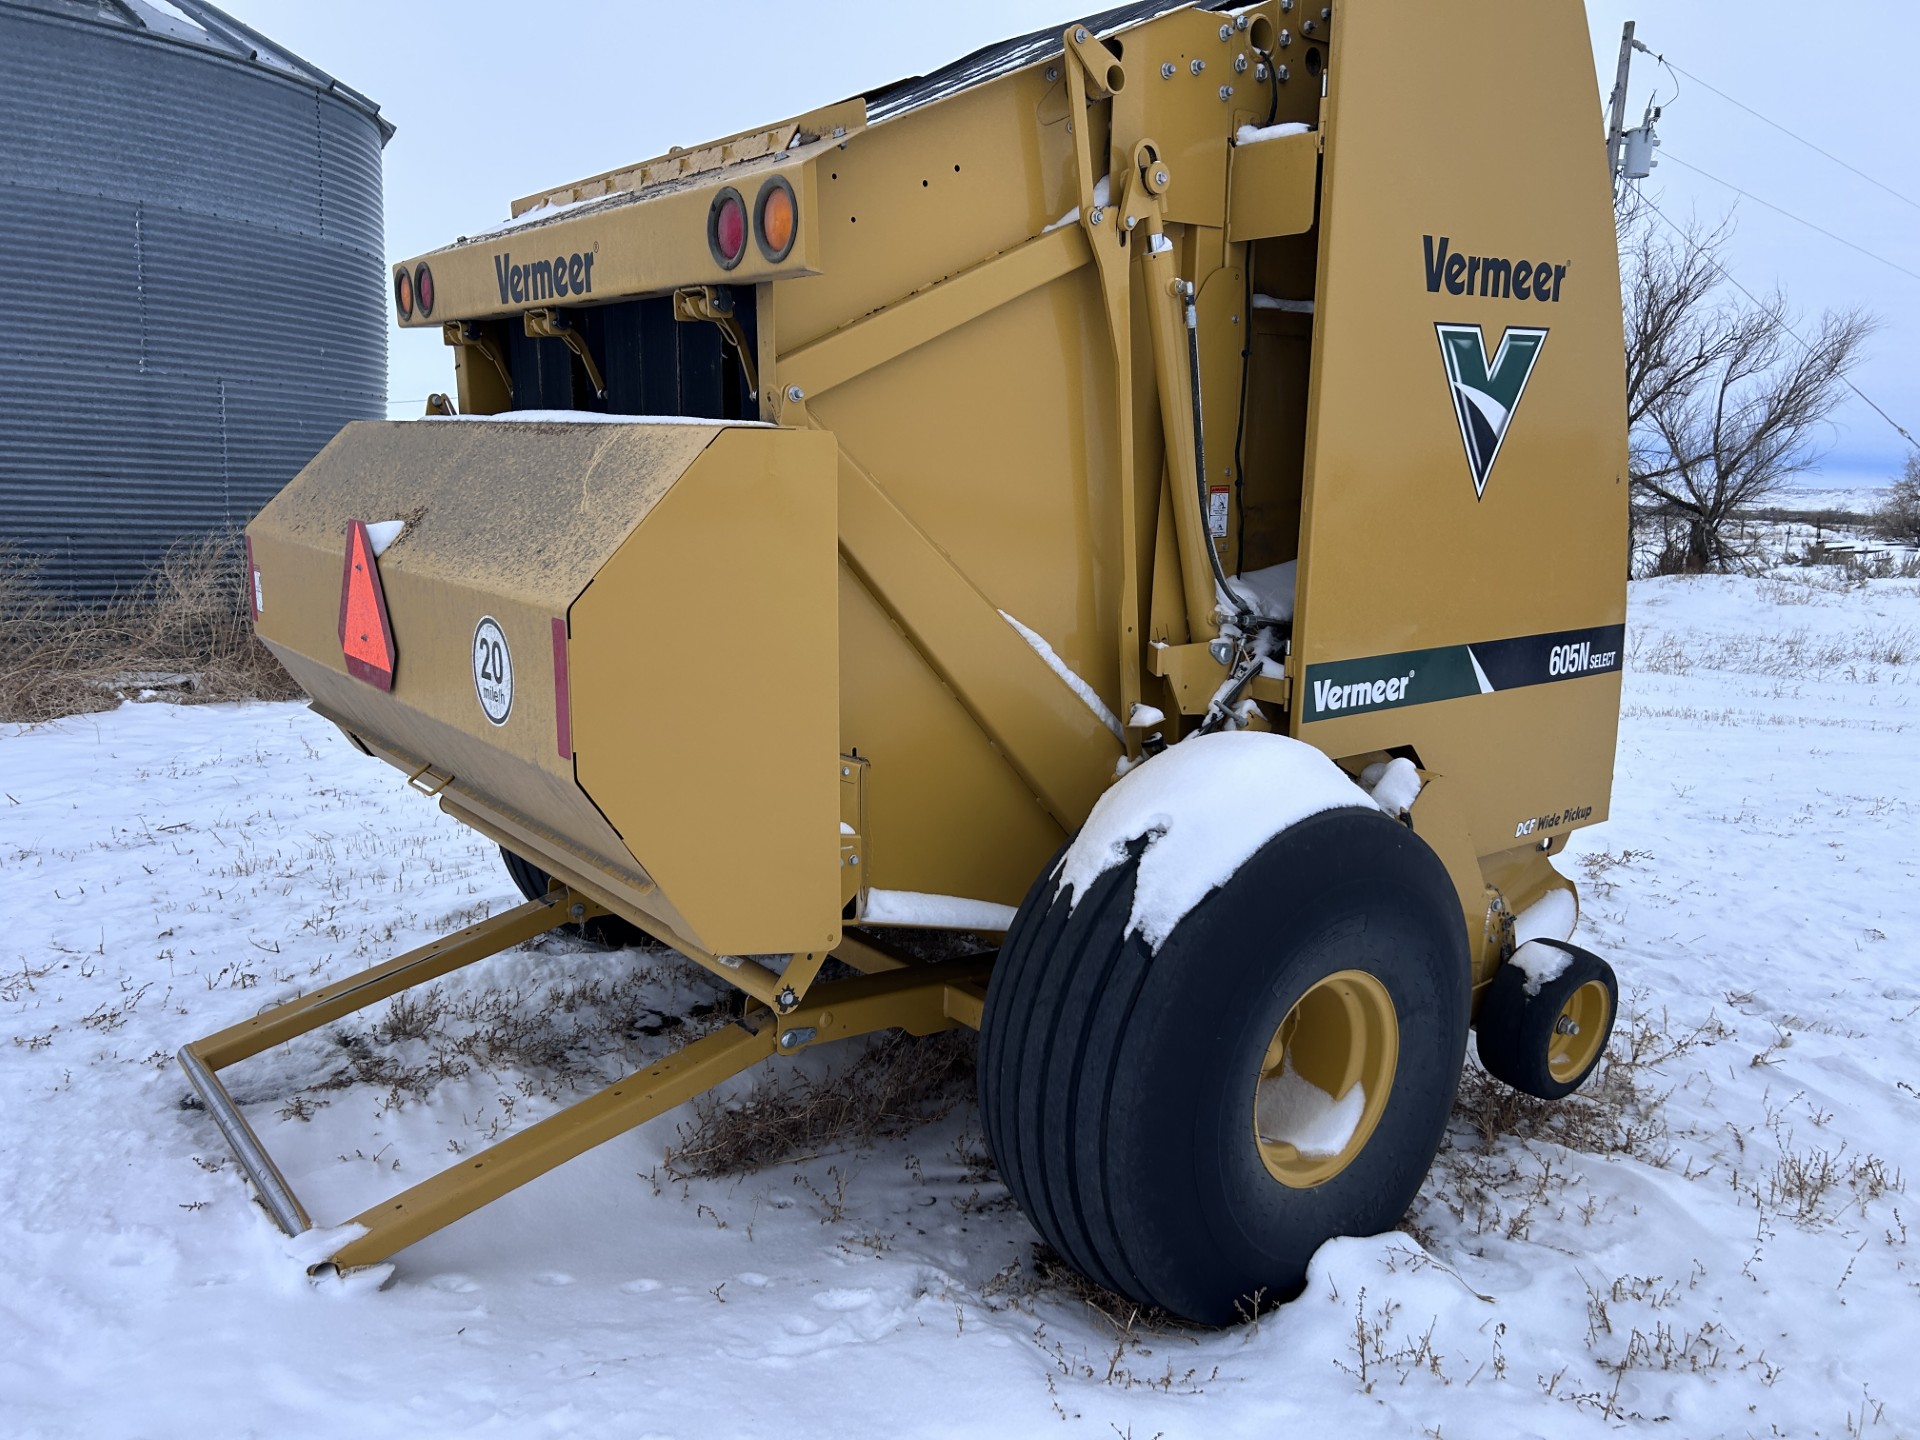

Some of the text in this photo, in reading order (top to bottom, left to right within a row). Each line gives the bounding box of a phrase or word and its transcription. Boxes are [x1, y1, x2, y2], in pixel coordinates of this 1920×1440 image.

[494, 251, 594, 305] Vermeer
[1422, 234, 1567, 302] Vermeer
[480, 637, 503, 685] 20
[1549, 641, 1616, 676] 605N SELECT
[1313, 676, 1409, 712] Vermeer
[1514, 806, 1592, 838] DCF Wide Pickup
